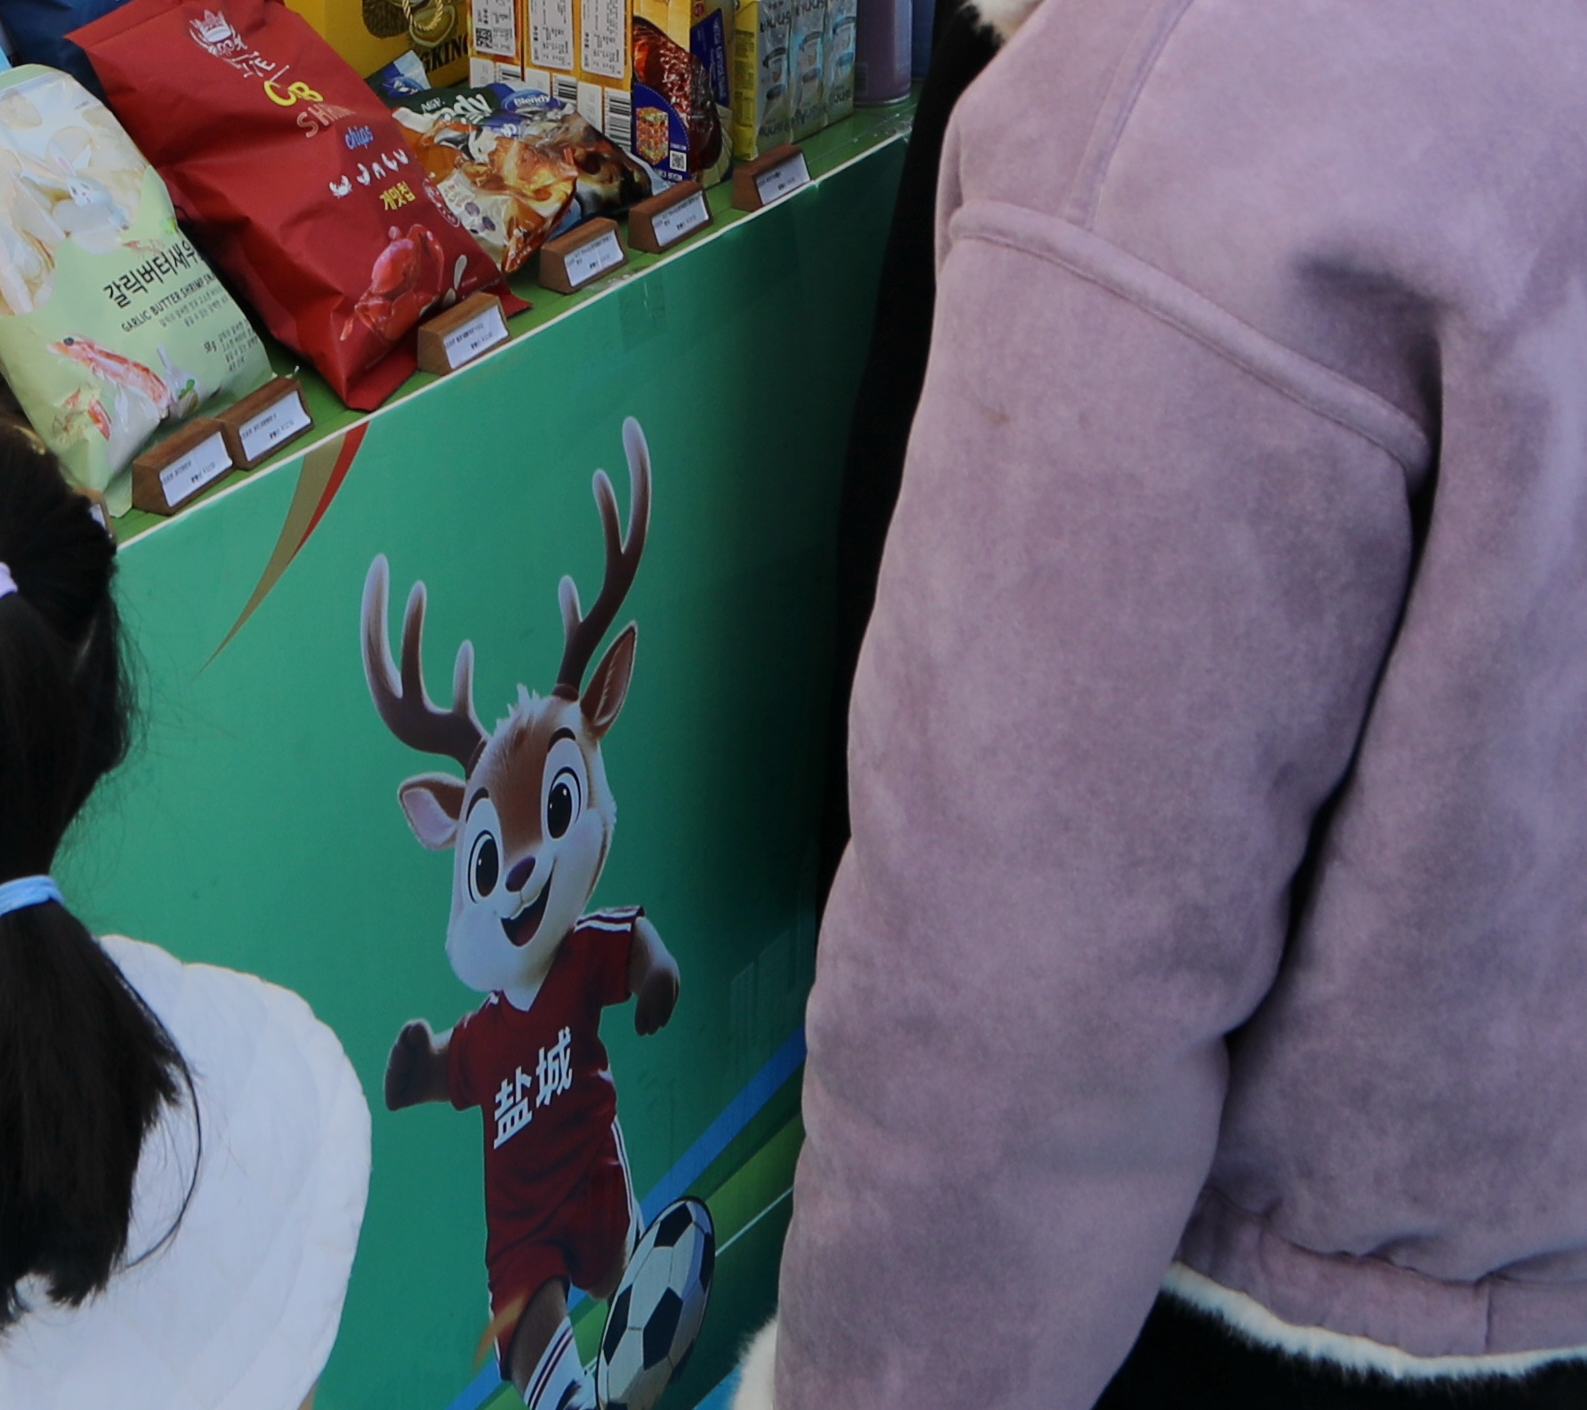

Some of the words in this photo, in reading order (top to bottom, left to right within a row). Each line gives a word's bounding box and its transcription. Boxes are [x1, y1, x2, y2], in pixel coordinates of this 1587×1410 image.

[343, 124, 375, 152] chips
[120, 311, 152, 333] GARLIC
[150, 293, 182, 317] BUTTER
[179, 280, 208, 301] SHRIMP
[491, 1023, 573, 1151] 盐城
